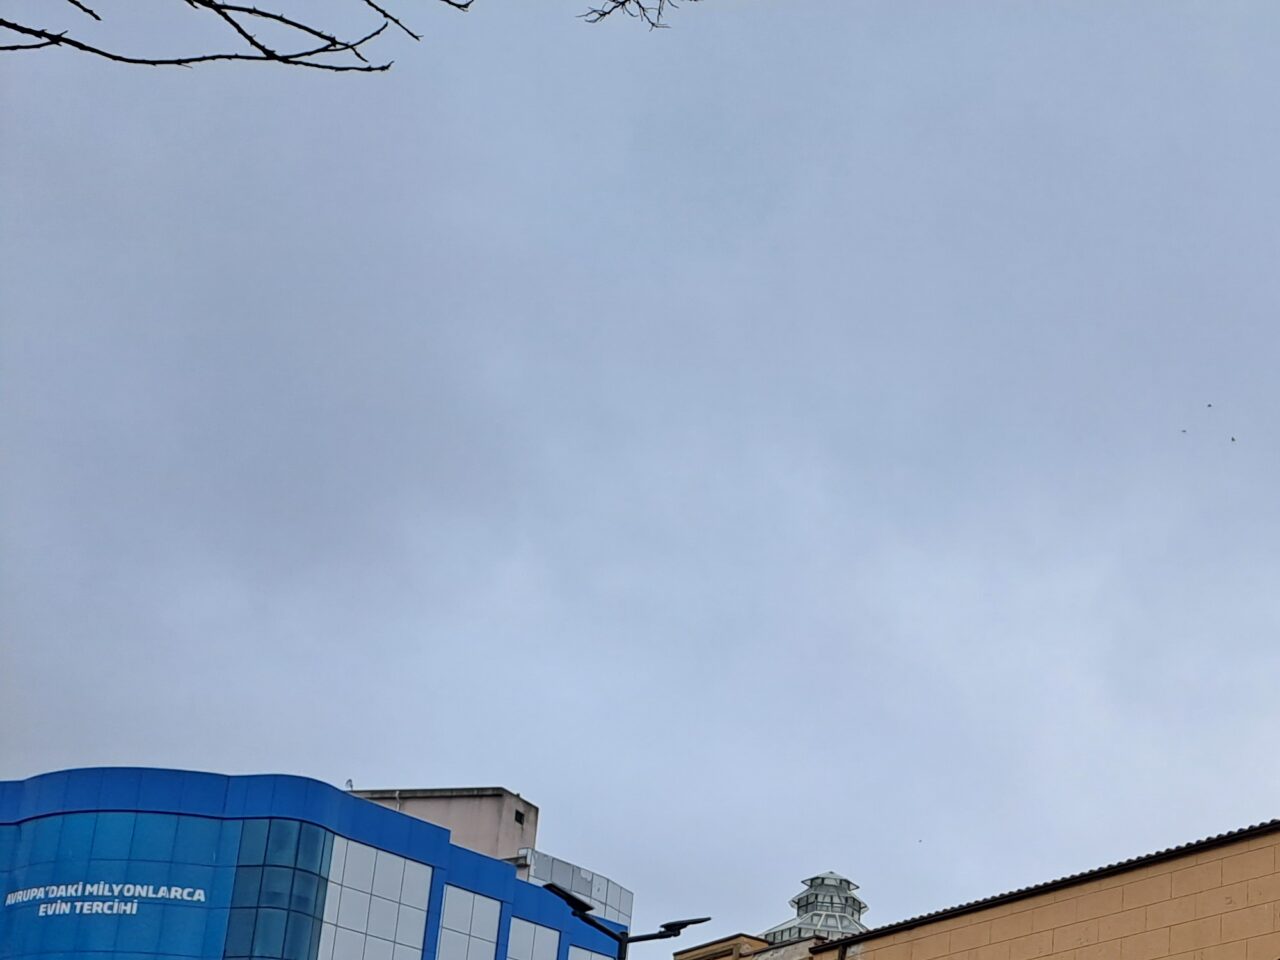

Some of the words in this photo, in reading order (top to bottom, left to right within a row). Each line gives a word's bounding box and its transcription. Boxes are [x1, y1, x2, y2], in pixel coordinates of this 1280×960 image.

[5, 881, 83, 906] AVRUPA'DAKİ
[85, 881, 206, 902] MİLYONLARCA
[38, 900, 70, 916] EVİN
[75, 899, 138, 915] TERCİHİ
